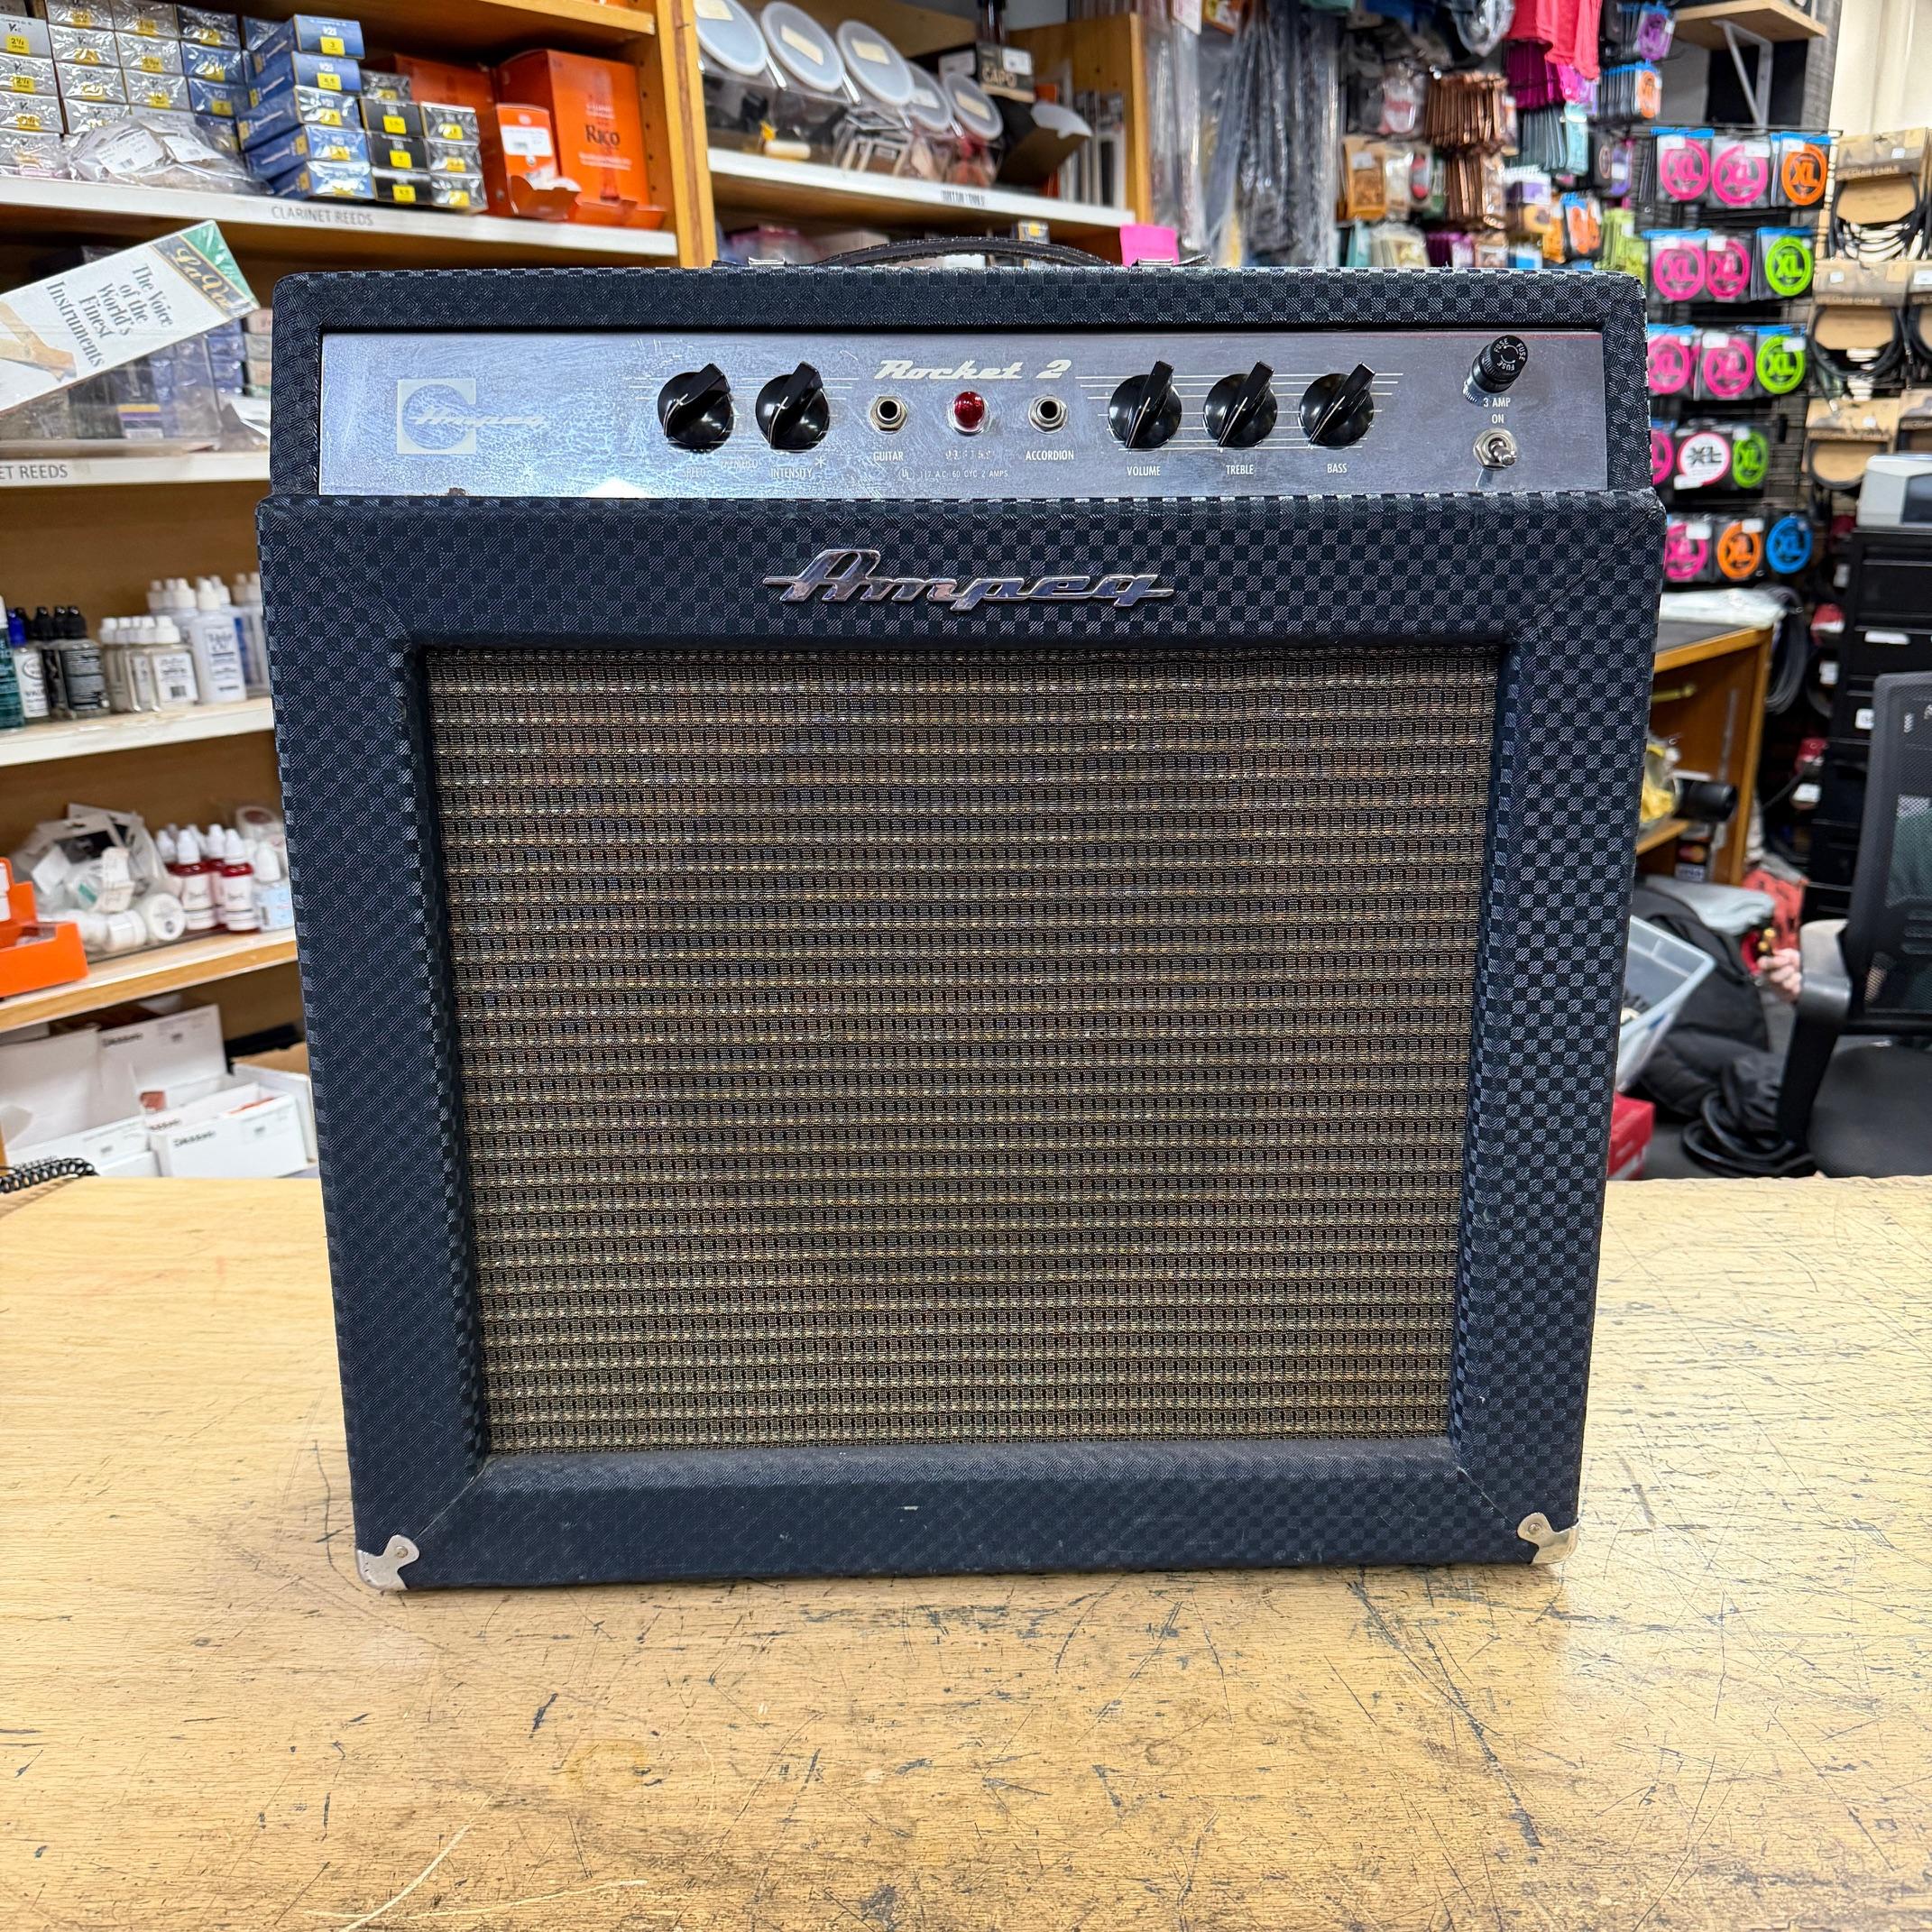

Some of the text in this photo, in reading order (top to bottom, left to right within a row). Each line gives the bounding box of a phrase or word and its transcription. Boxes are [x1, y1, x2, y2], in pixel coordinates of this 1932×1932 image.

[271, 206, 374, 225] CLARINET REEDS
[1774, 253, 1803, 279] XL
[133, 264, 173, 326] The Voice
[97, 283, 134, 336] World's
[119, 284, 149, 324] of the
[46, 281, 105, 367] Instruments
[79, 296, 114, 338] Finest
[1494, 338, 1508, 353] FUSE
[1516, 343, 1526, 361] FUSE
[874, 359, 1072, 380] Rocket 2
[1497, 361, 1515, 372] FUSE
[1483, 398, 1511, 407] 3 AMP
[1491, 414, 1504, 424] ON
[873, 451, 904, 462] GUITAR
[1026, 450, 1074, 461] ACCORDION
[1688, 446, 1723, 466] XL
[19, 464, 69, 479] REEDS
[770, 468, 812, 478] INTENSITY
[952, 470, 961, 478] 60
[981, 470, 986, 478] 2
[989, 470, 1008, 478] AMPS
[1127, 465, 1161, 476] VOLUME
[1226, 465, 1255, 475] TREBLE
[1327, 463, 1348, 474] BASS
[762, 548, 1173, 612] Ampeg
